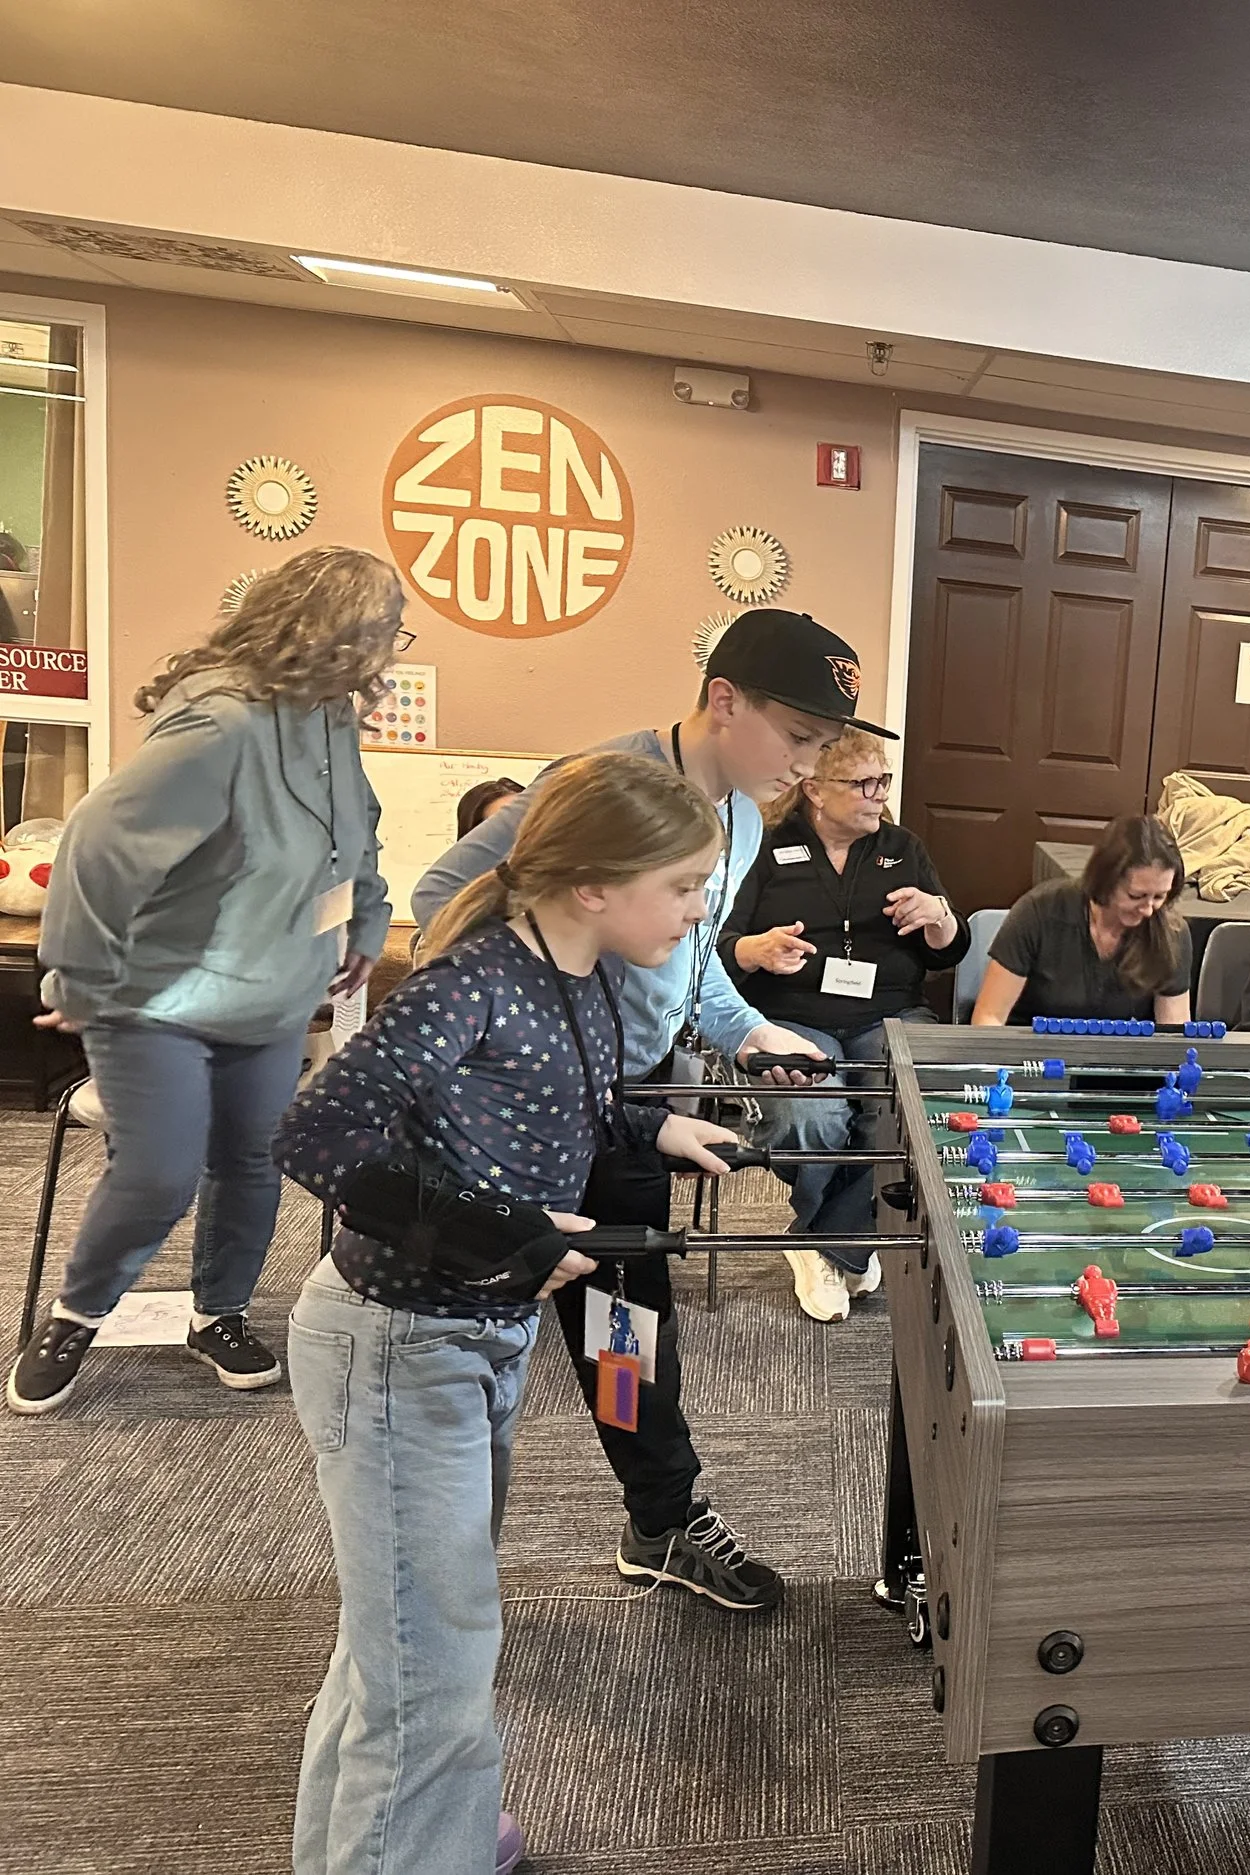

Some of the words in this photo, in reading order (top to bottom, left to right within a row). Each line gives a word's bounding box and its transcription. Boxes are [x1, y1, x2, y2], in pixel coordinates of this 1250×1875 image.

[394, 405, 622, 521] ZEN
[393, 510, 624, 625] ZONE
[0, 647, 87, 673] SOURCE
[0, 670, 29, 691] ER
